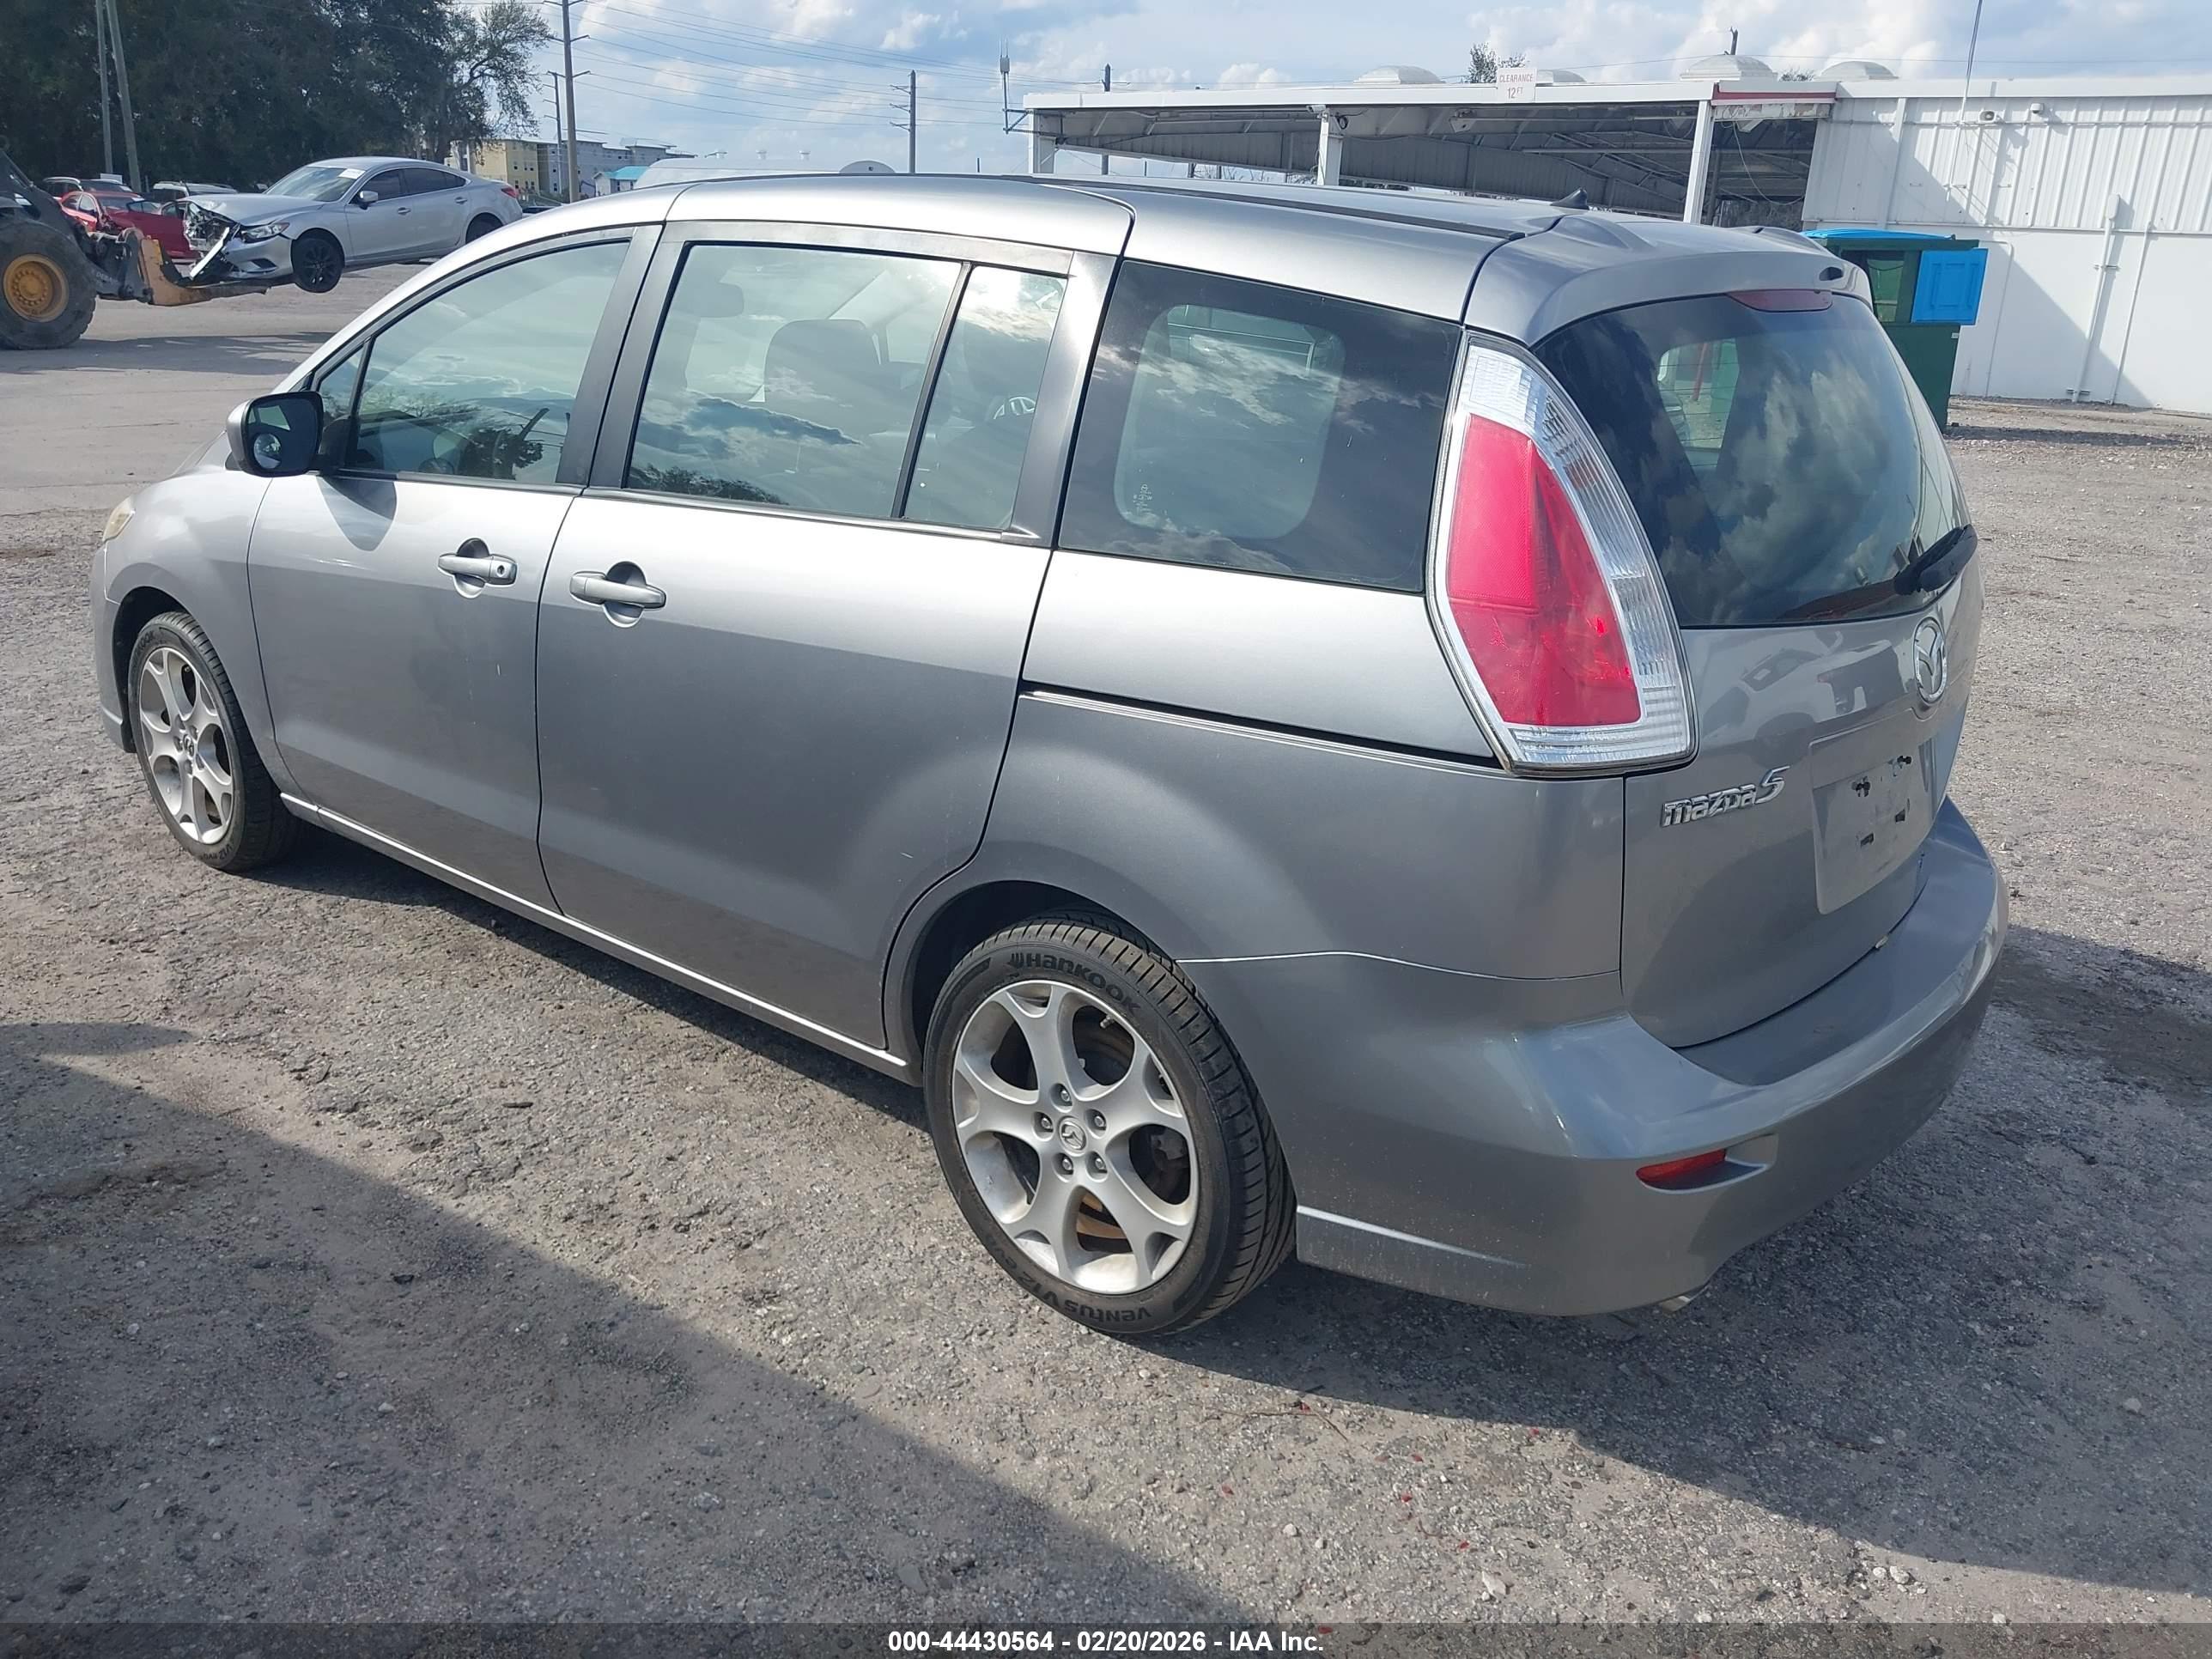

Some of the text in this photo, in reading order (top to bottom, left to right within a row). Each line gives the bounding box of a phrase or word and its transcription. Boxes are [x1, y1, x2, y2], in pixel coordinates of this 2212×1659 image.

[1498, 74, 1534, 83] CLEARANCE
[1507, 87, 1516, 100] 12
[1028, 951, 1141, 1015] HANKOOK
[1064, 1299, 1152, 1322] VENTUS
